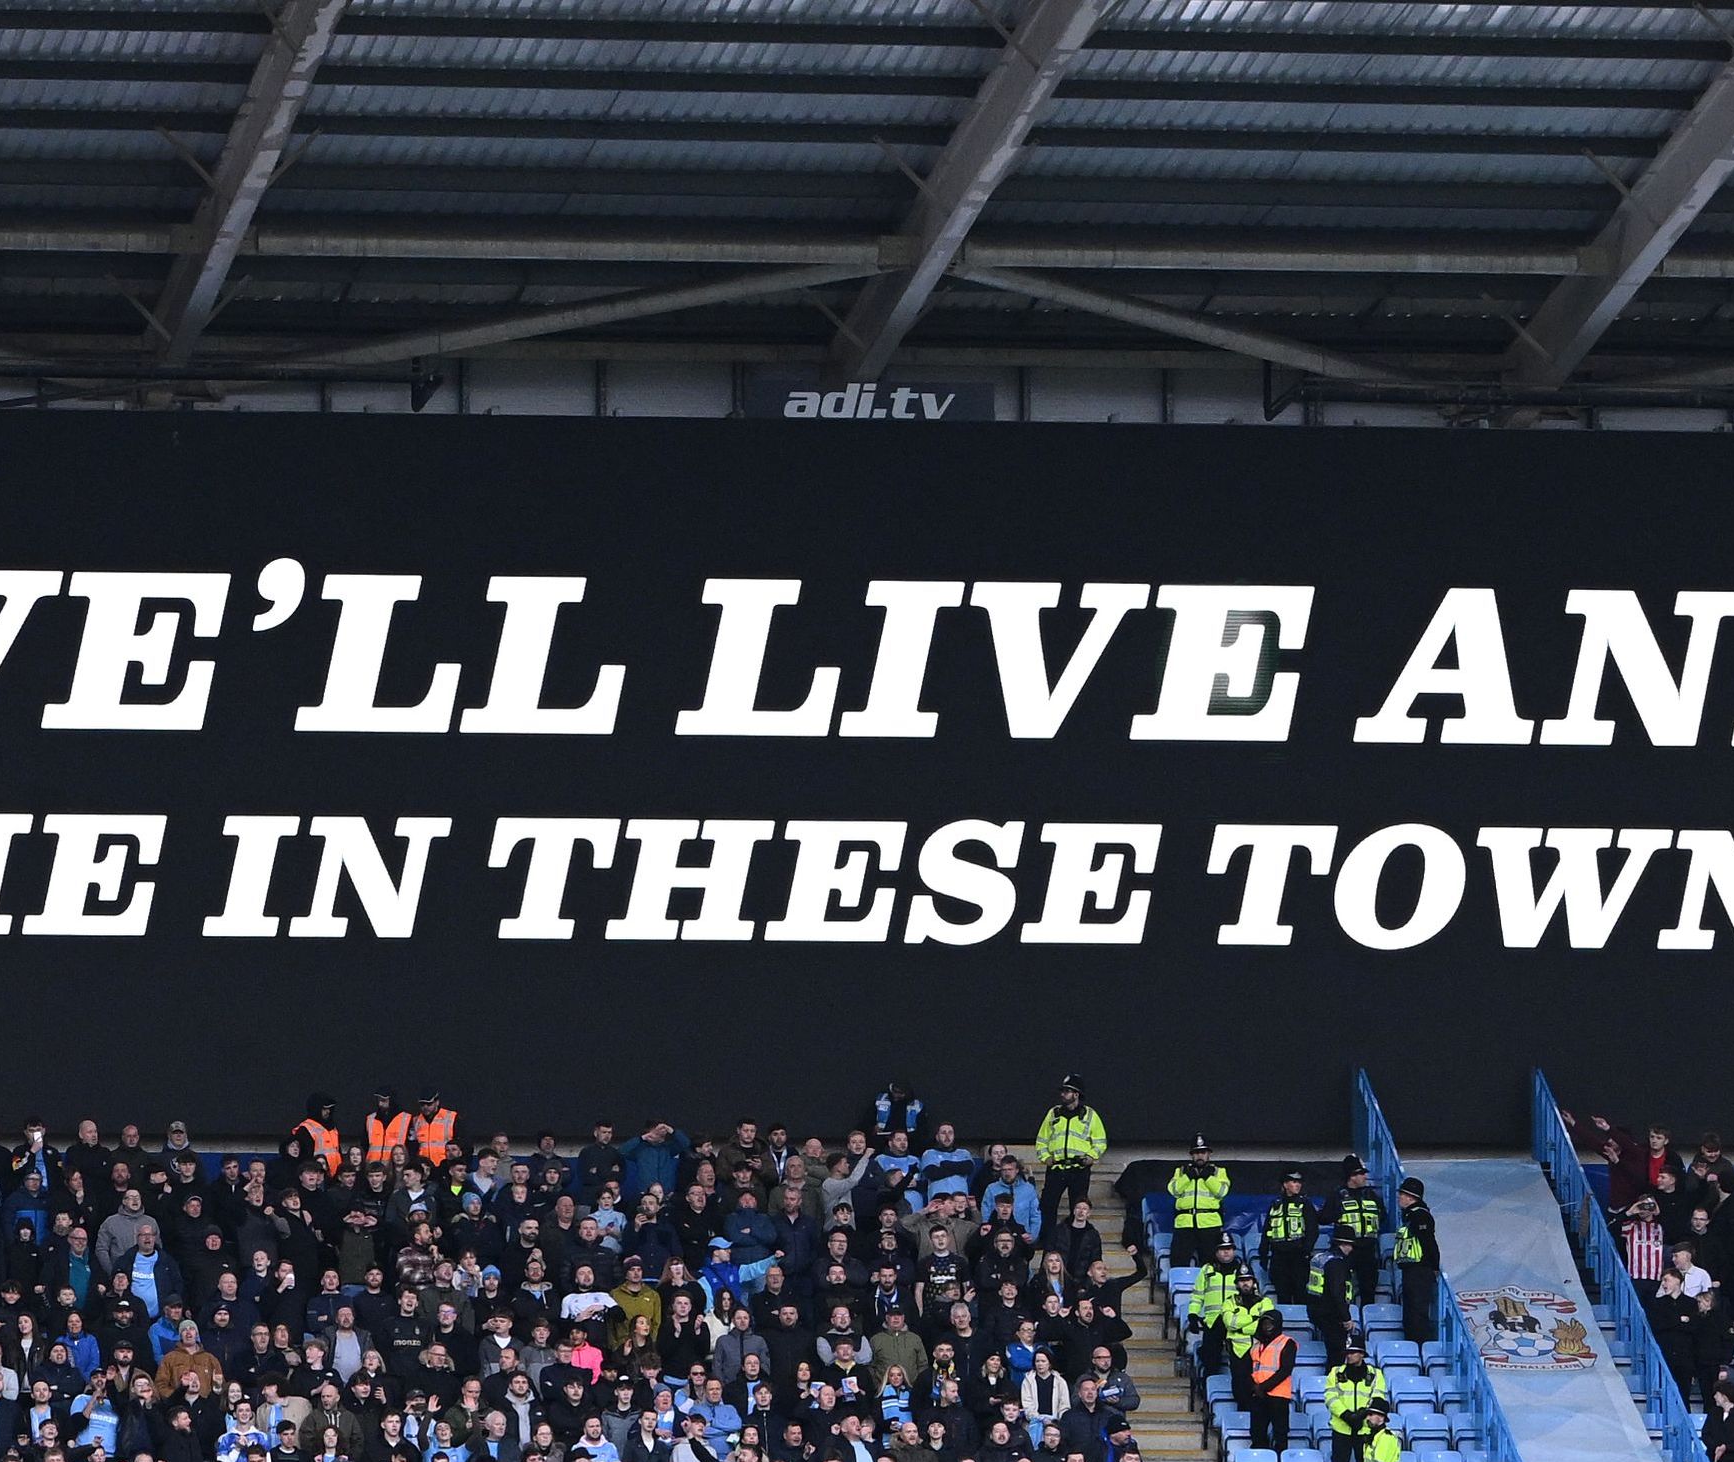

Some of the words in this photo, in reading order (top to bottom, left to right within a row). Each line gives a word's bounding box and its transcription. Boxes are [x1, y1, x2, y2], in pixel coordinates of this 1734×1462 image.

[783, 383, 956, 420] adi.tv
[676, 580, 1316, 742] LIVE
[203, 817, 453, 938] IN
[489, 819, 1163, 946] THESE
